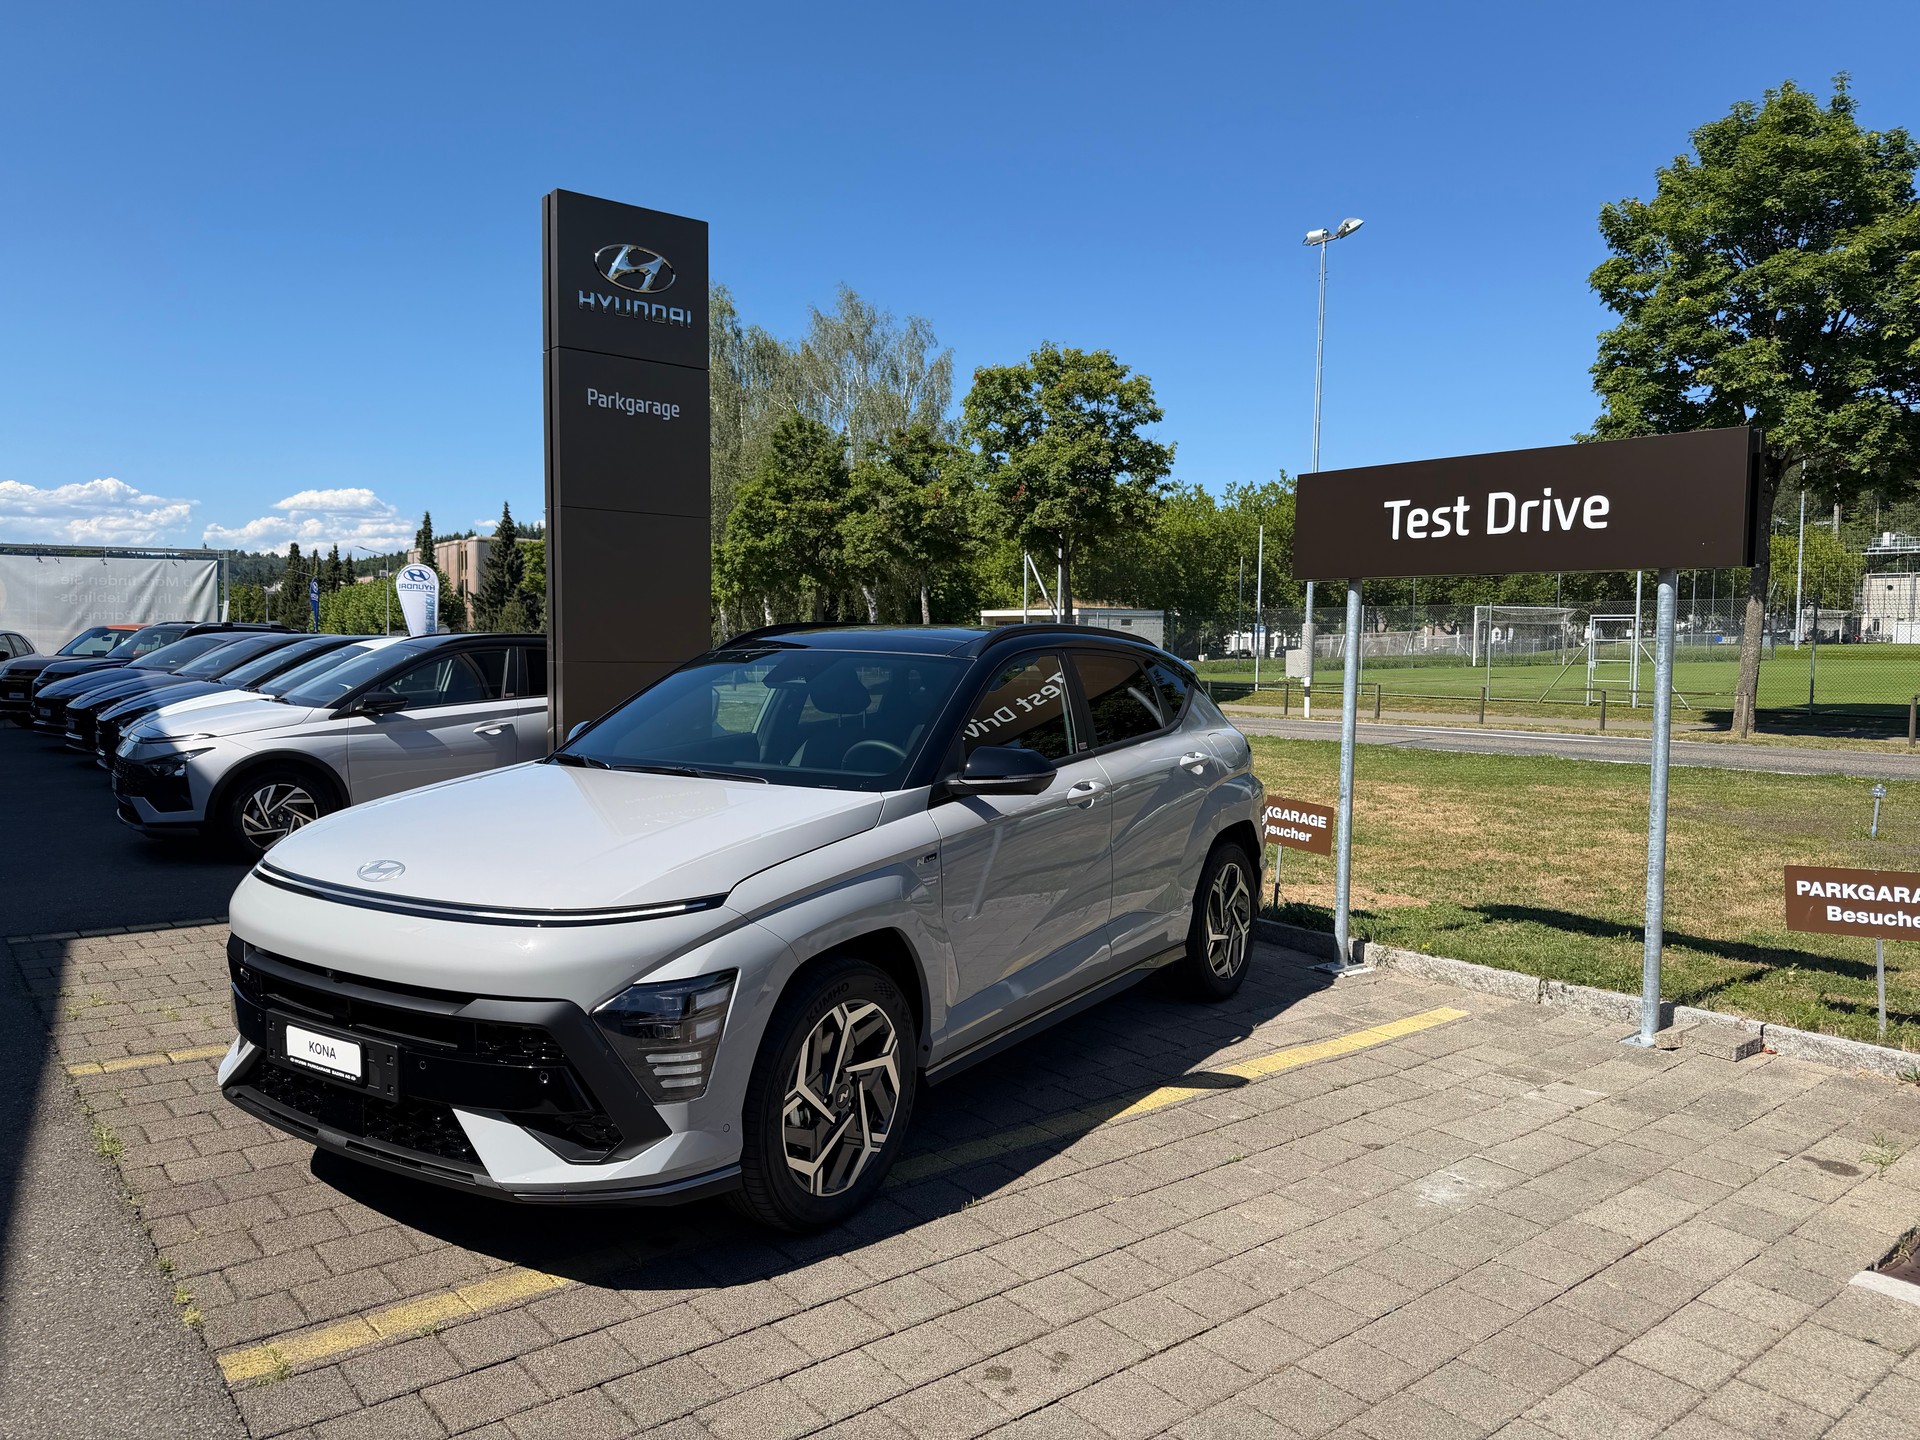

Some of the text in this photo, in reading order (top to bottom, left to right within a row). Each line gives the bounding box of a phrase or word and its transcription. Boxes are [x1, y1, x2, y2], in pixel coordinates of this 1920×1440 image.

[578, 290, 692, 328] HYUNDAI
[587, 388, 680, 420] Parkgarage
[1384, 488, 1610, 540] Test Drive
[1265, 805, 1327, 828] KGARAGE
[1796, 880, 1920, 904] PARKGARA
[1826, 905, 1920, 929] Besuche
[806, 982, 850, 1025] KUMHO
[309, 1040, 336, 1060] KONA
